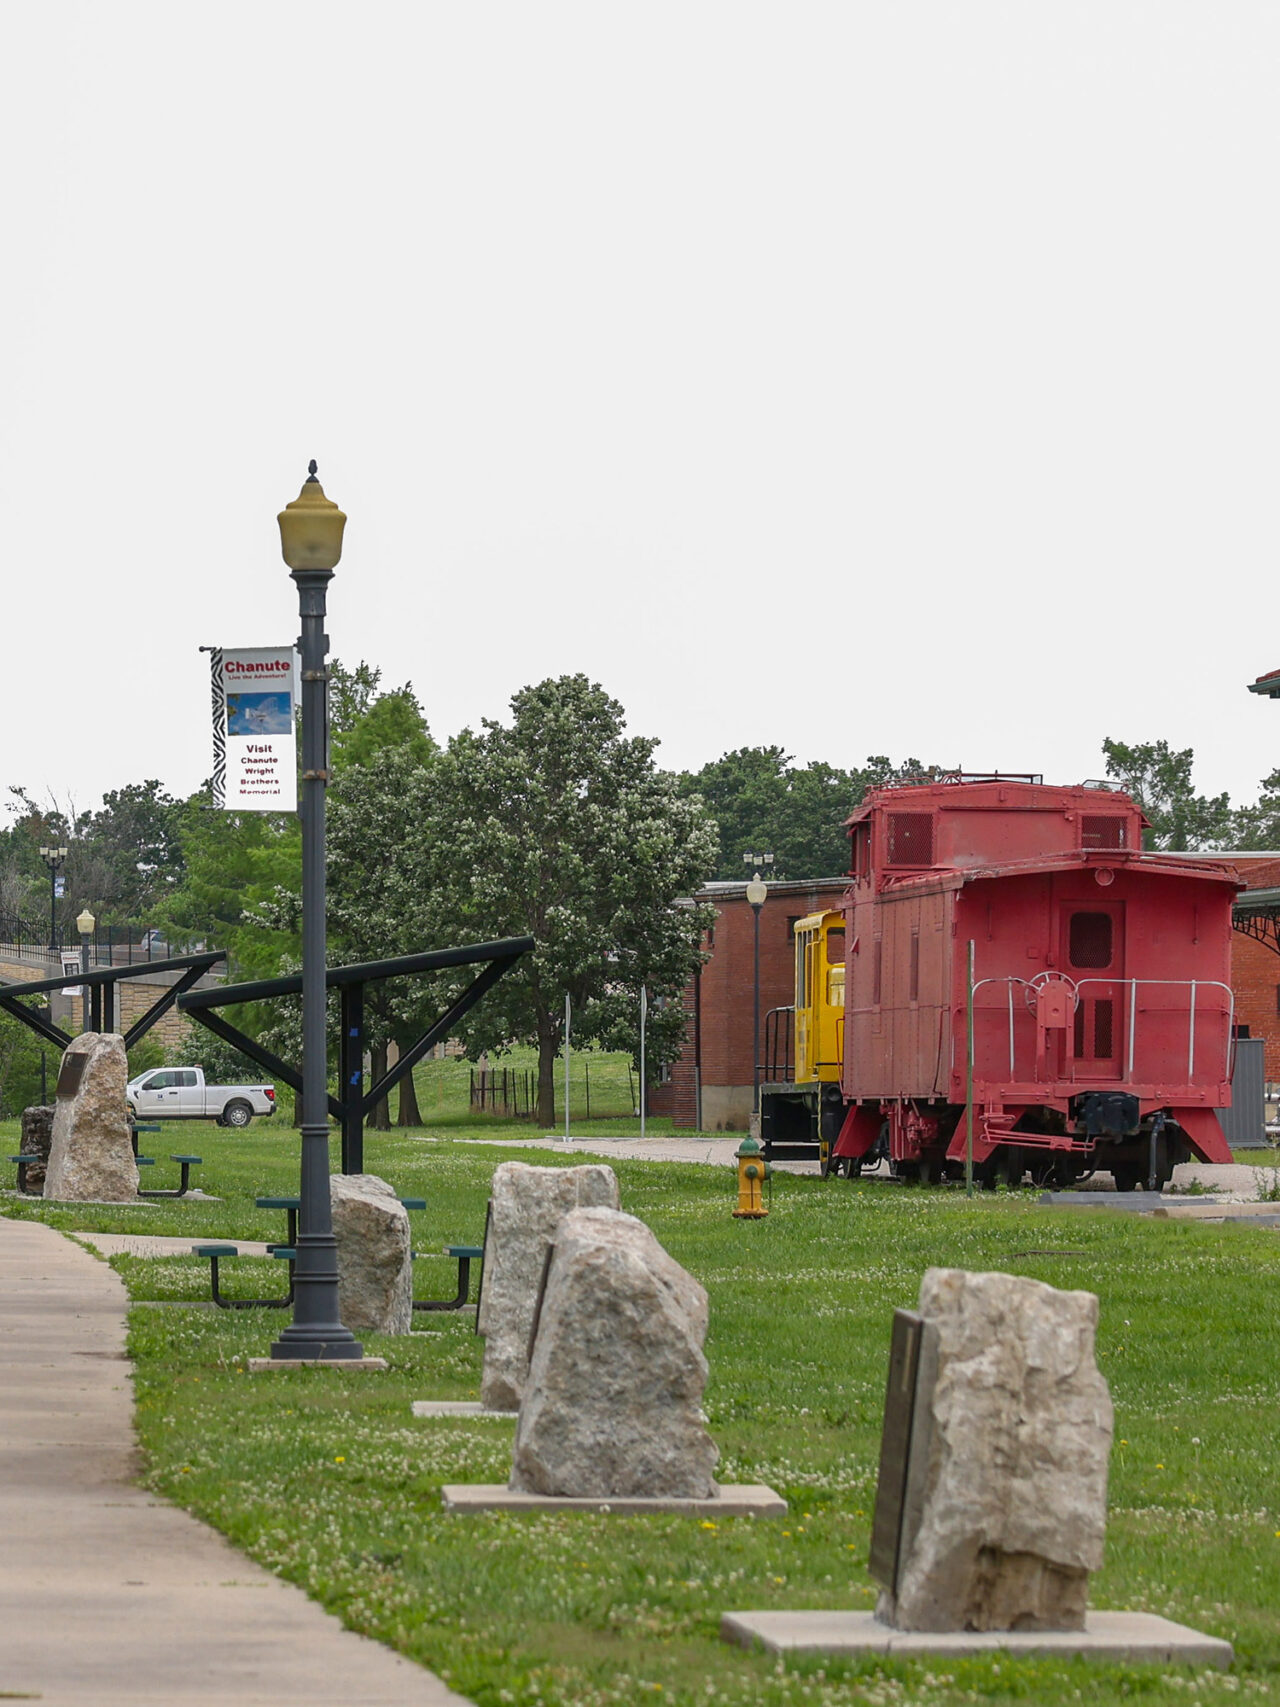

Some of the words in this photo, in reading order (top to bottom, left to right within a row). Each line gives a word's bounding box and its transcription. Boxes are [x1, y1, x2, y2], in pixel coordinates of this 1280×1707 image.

[224, 660, 291, 673] Chanute
[246, 744, 272, 753] Visit
[245, 768, 274, 776] Wright
